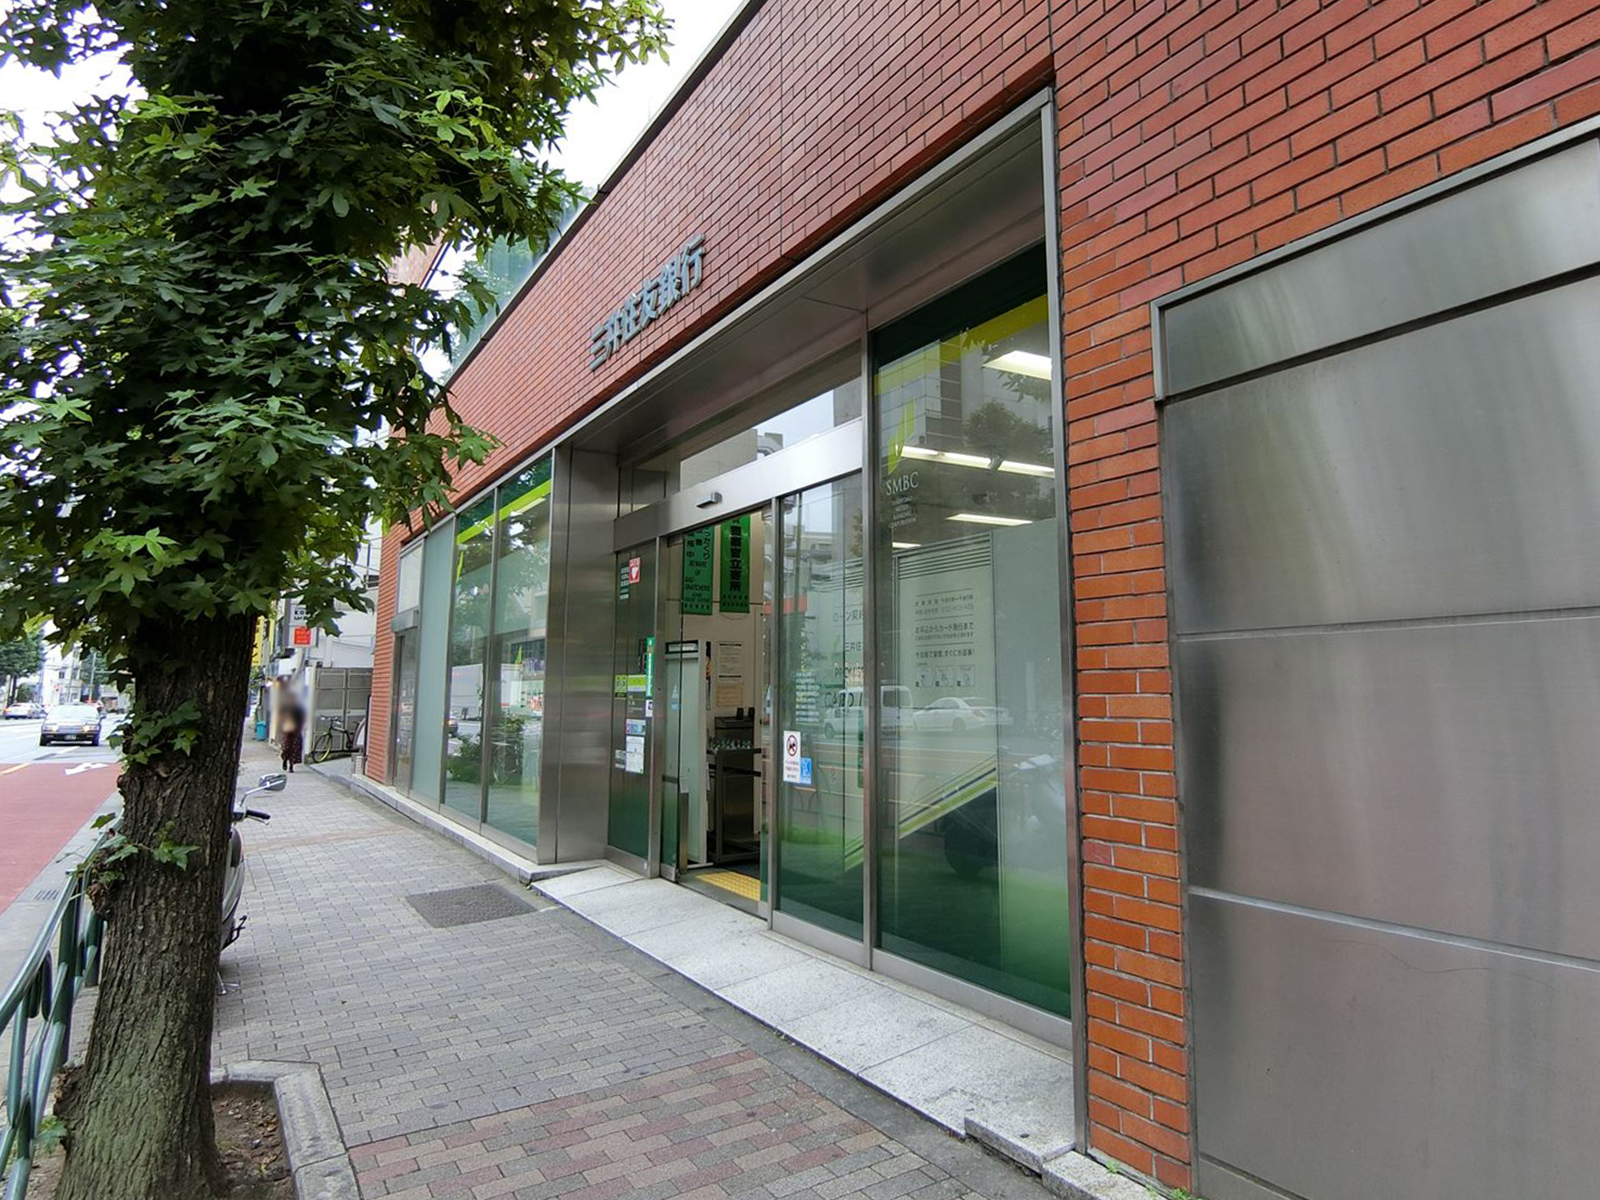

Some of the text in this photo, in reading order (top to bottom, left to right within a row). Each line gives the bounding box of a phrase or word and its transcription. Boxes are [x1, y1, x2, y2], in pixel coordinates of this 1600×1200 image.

[588, 232, 706, 370] 三井住友銀行
[885, 471, 919, 496] SMBC
